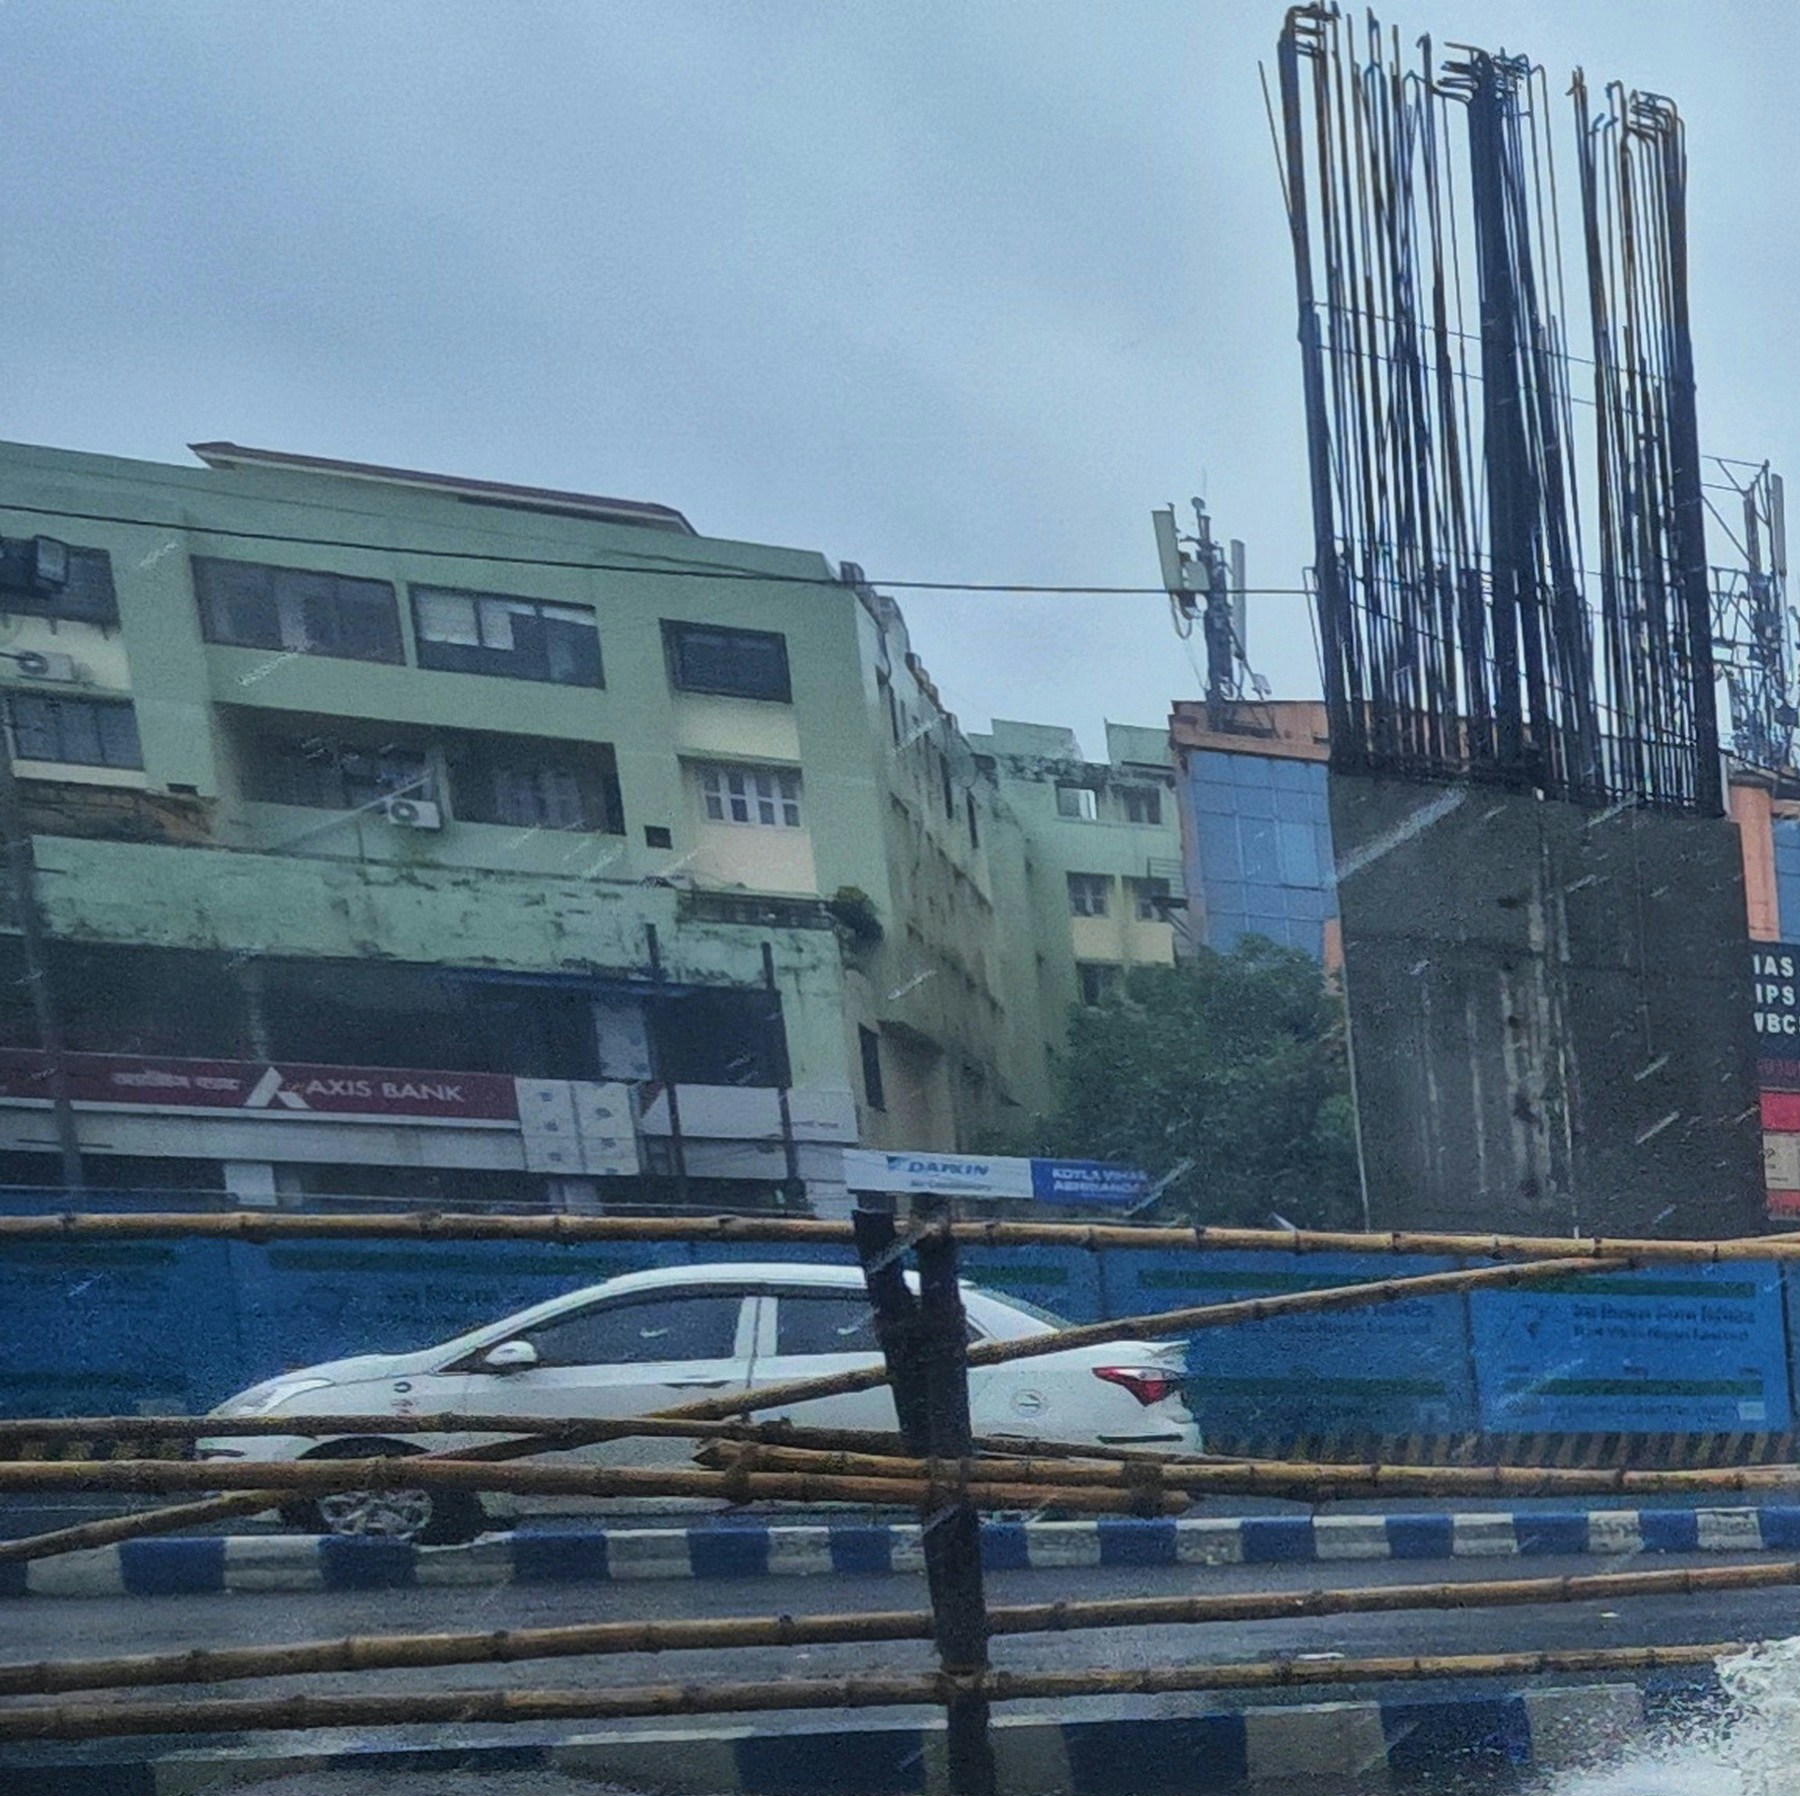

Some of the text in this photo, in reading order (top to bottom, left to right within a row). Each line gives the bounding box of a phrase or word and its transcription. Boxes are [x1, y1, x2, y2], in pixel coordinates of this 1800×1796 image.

[1752, 954, 1794, 978] IAS
[1755, 983, 1796, 1006] IPS
[305, 1078, 466, 1103] AXIS BANK
[908, 1161, 989, 1176] DAIKIN
